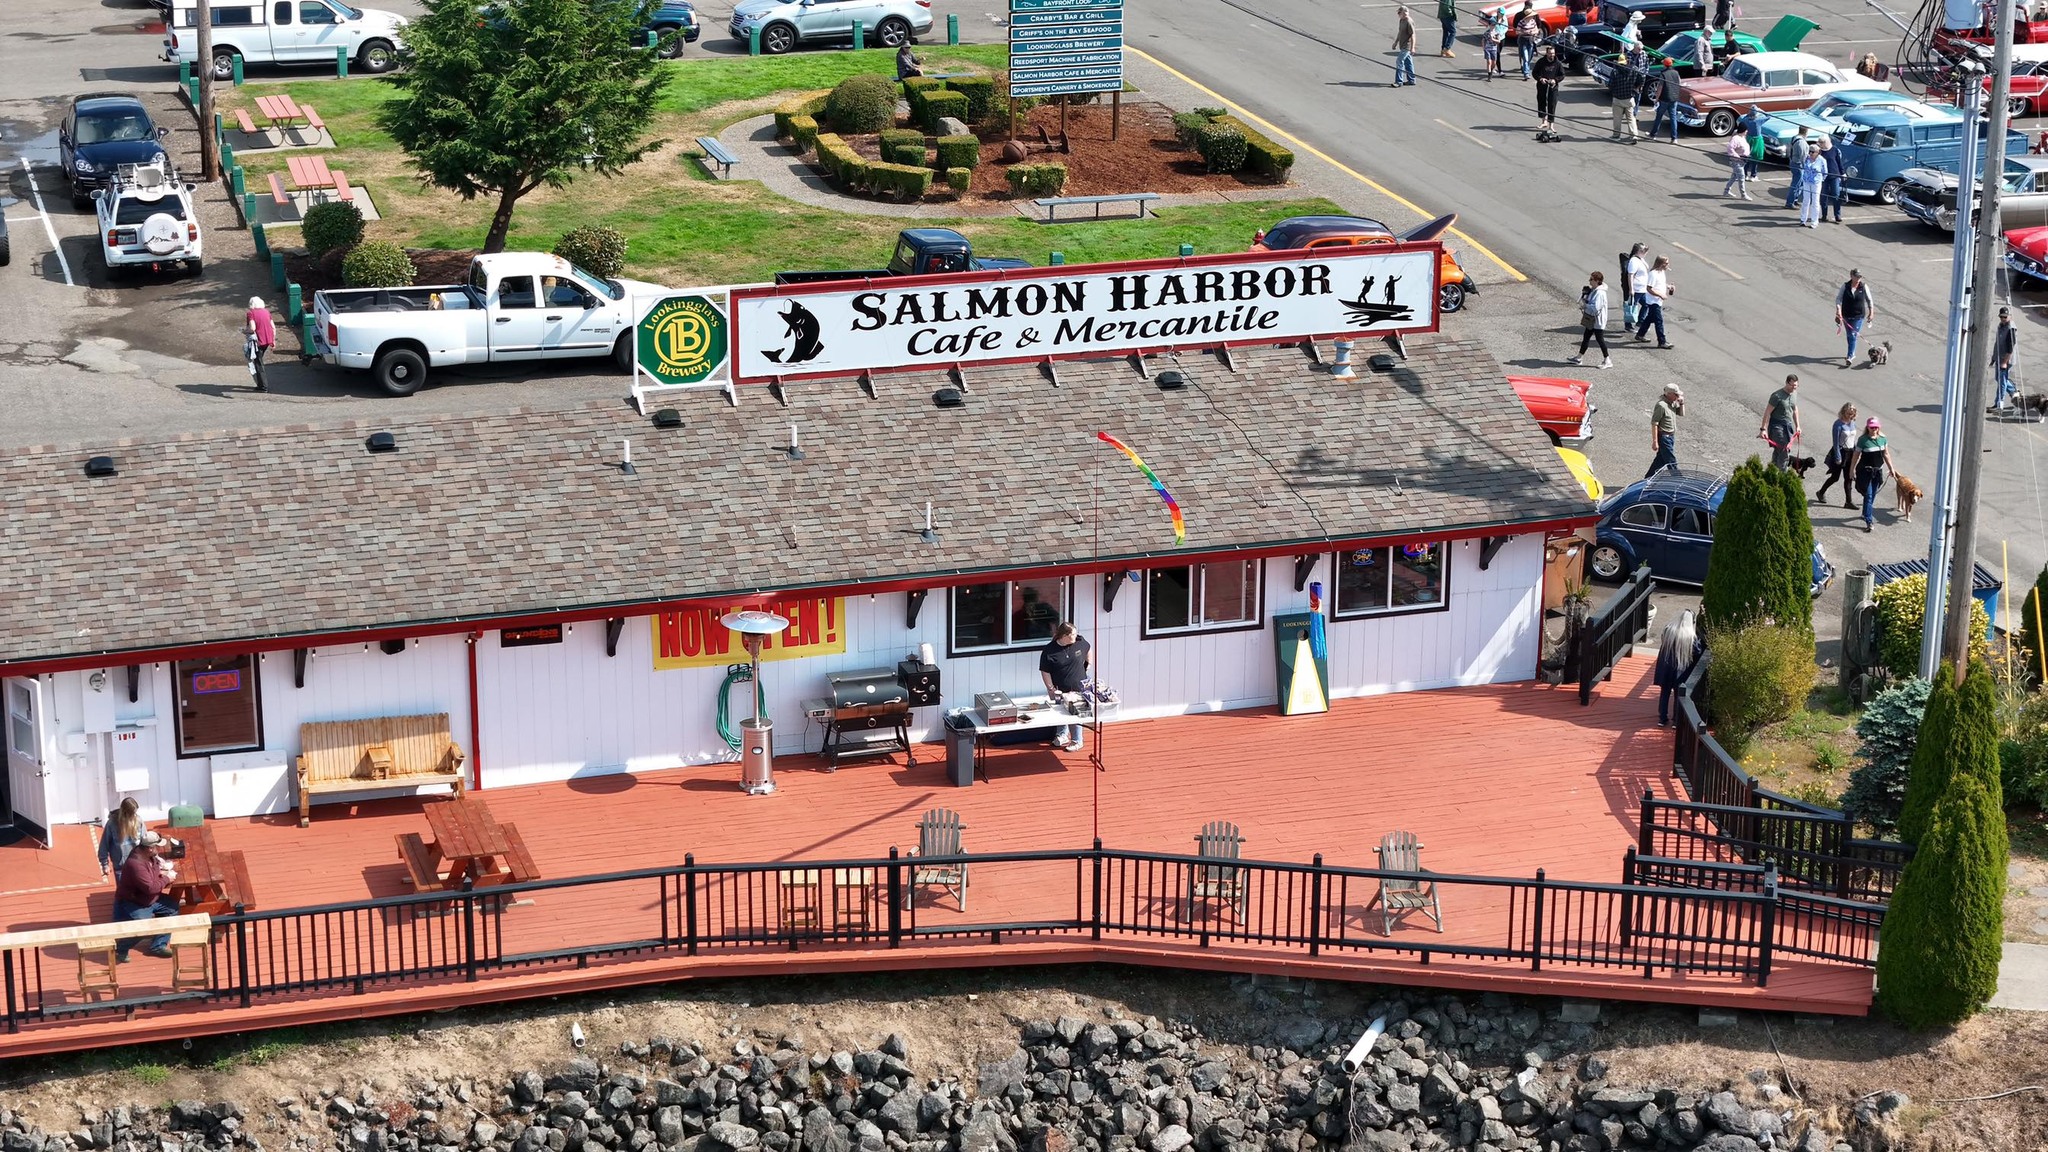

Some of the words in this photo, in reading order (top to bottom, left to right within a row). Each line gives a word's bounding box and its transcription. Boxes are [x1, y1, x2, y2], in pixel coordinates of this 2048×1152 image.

[1085, 67, 1121, 75] MERCANTILE
[1083, 81, 1120, 89] SMOKEHOUSE
[851, 281, 1088, 331] SALMON
[1107, 264, 1333, 312] HARBOR
[645, 300, 719, 330] Lookingglass
[907, 325, 1003, 357] Cafe
[1015, 327, 1042, 349] &
[1053, 305, 1280, 346] Mercantile
[656, 359, 711, 377] Brewery
[660, 606, 731, 658] NOW
[742, 597, 837, 652] EN!
[196, 672, 239, 691] OPEN
